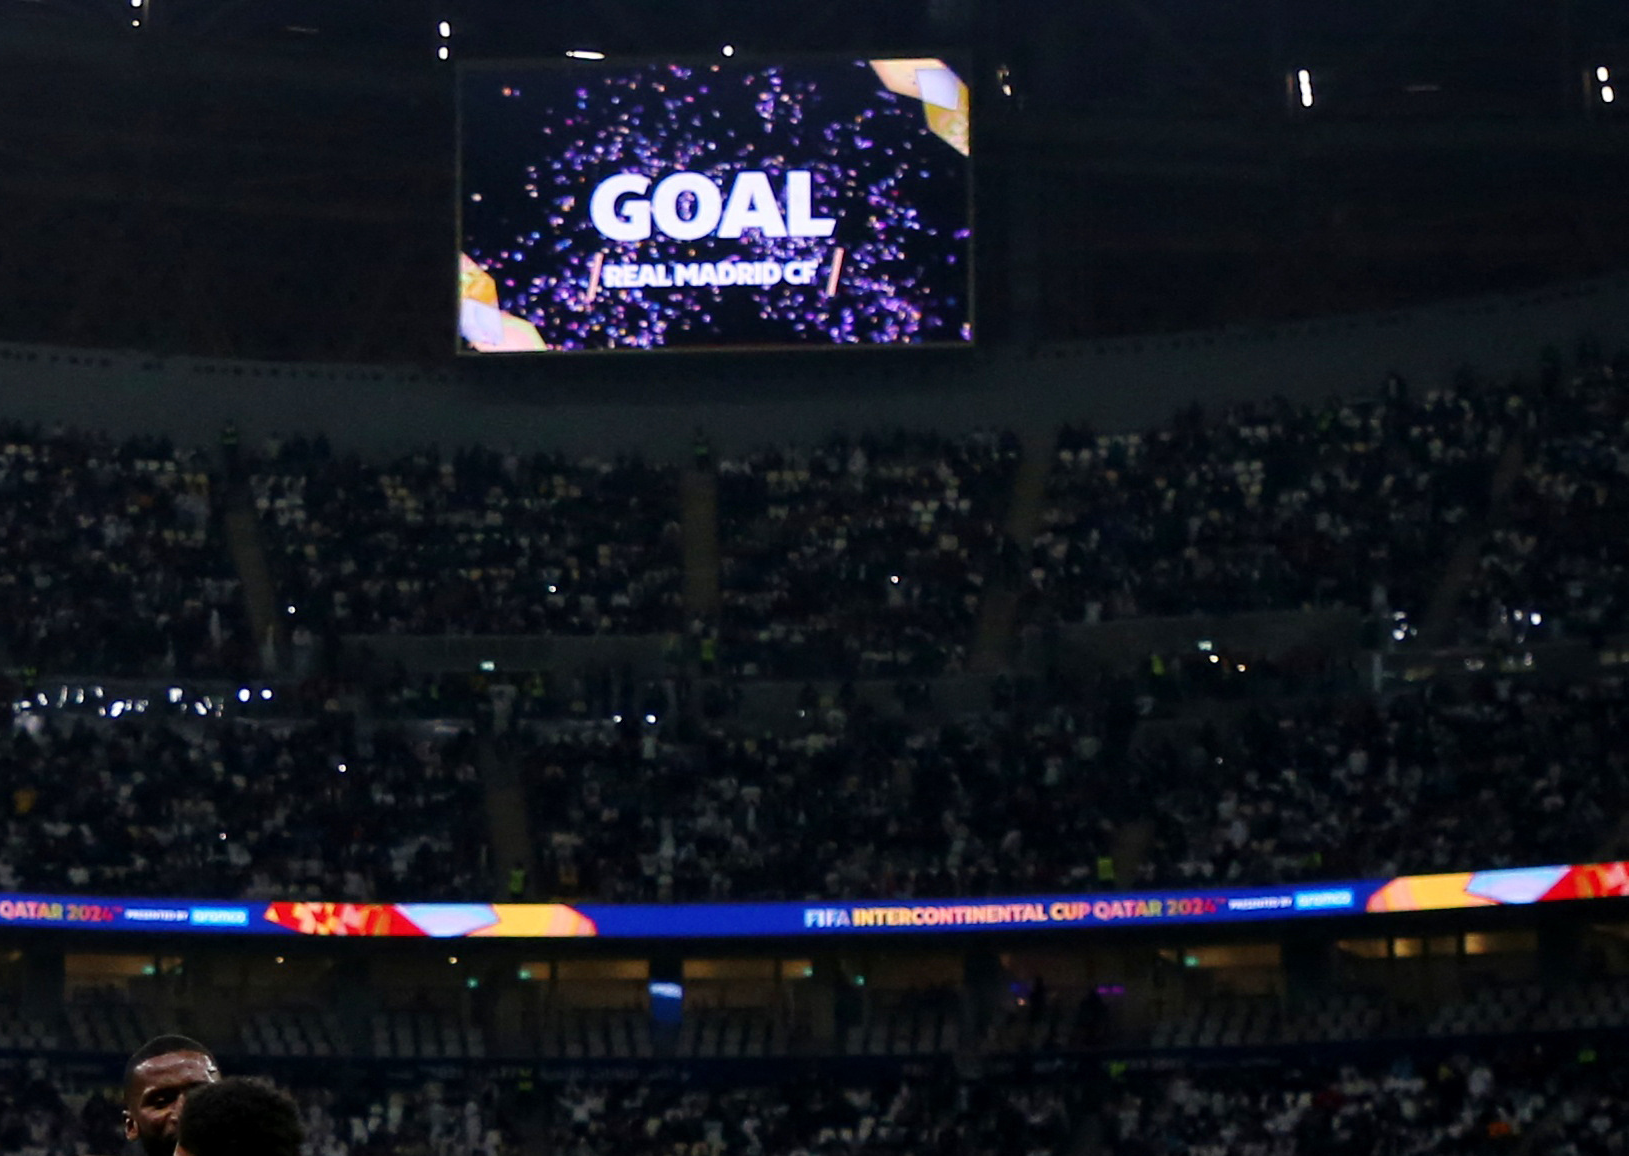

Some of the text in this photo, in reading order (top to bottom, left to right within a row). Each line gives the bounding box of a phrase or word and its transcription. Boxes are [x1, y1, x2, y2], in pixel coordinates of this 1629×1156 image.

[589, 170, 837, 242] GOAL
[601, 259, 819, 288] REAL MADRID CF
[804, 908, 851, 928] FIFA
[852, 903, 1048, 926] INTERCONTINENTAL
[1049, 902, 1091, 921] CUP
[1092, 900, 1162, 921] QATAR
